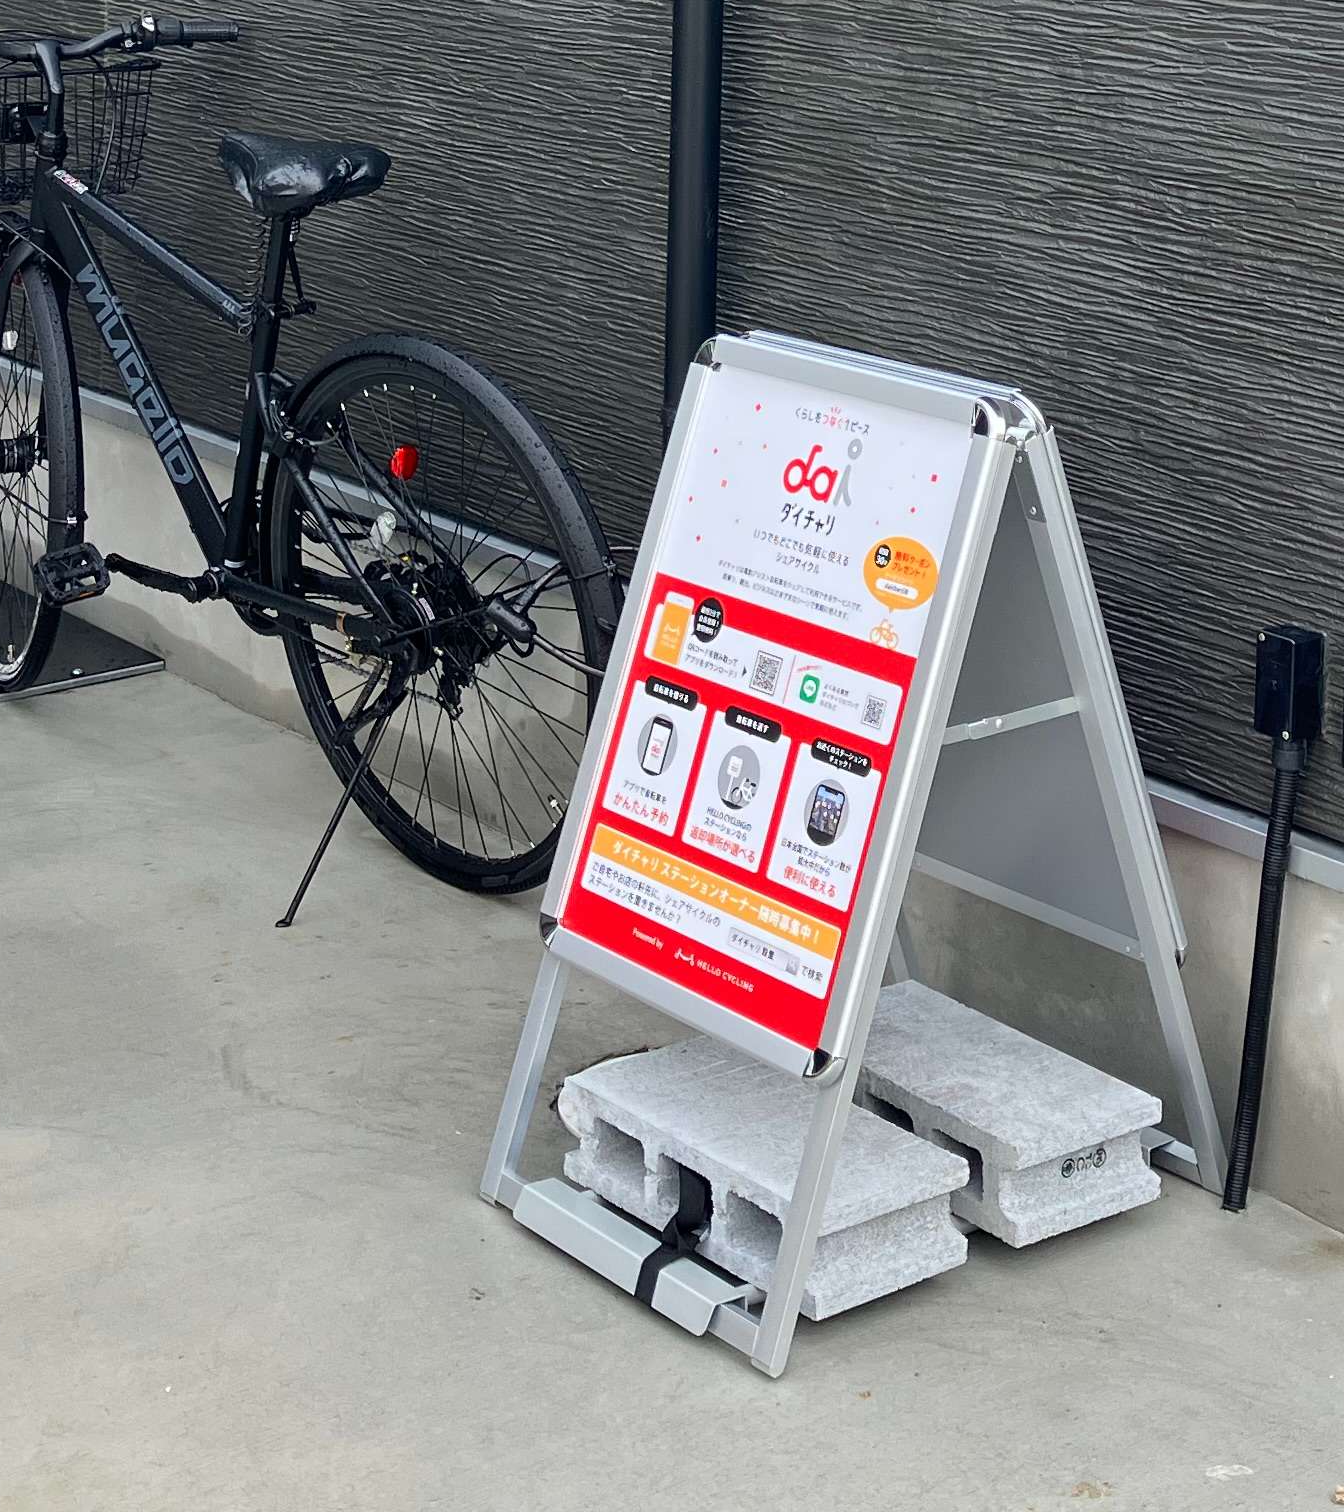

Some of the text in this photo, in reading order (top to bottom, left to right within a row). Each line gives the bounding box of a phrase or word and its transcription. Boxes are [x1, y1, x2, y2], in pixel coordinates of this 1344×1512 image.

[781, 502, 836, 536] ダイチャリ
[753, 527, 850, 567] いつでもどこでも気軽に使える
[775, 552, 821, 575] シェアサイクル
[613, 793, 669, 826] かんたん予約
[689, 825, 756, 864] 返却場所が選べる
[704, 817, 747, 842] ステーションなら
[611, 840, 660, 872] ダイチャリ
[783, 865, 837, 899] 便利に使える
